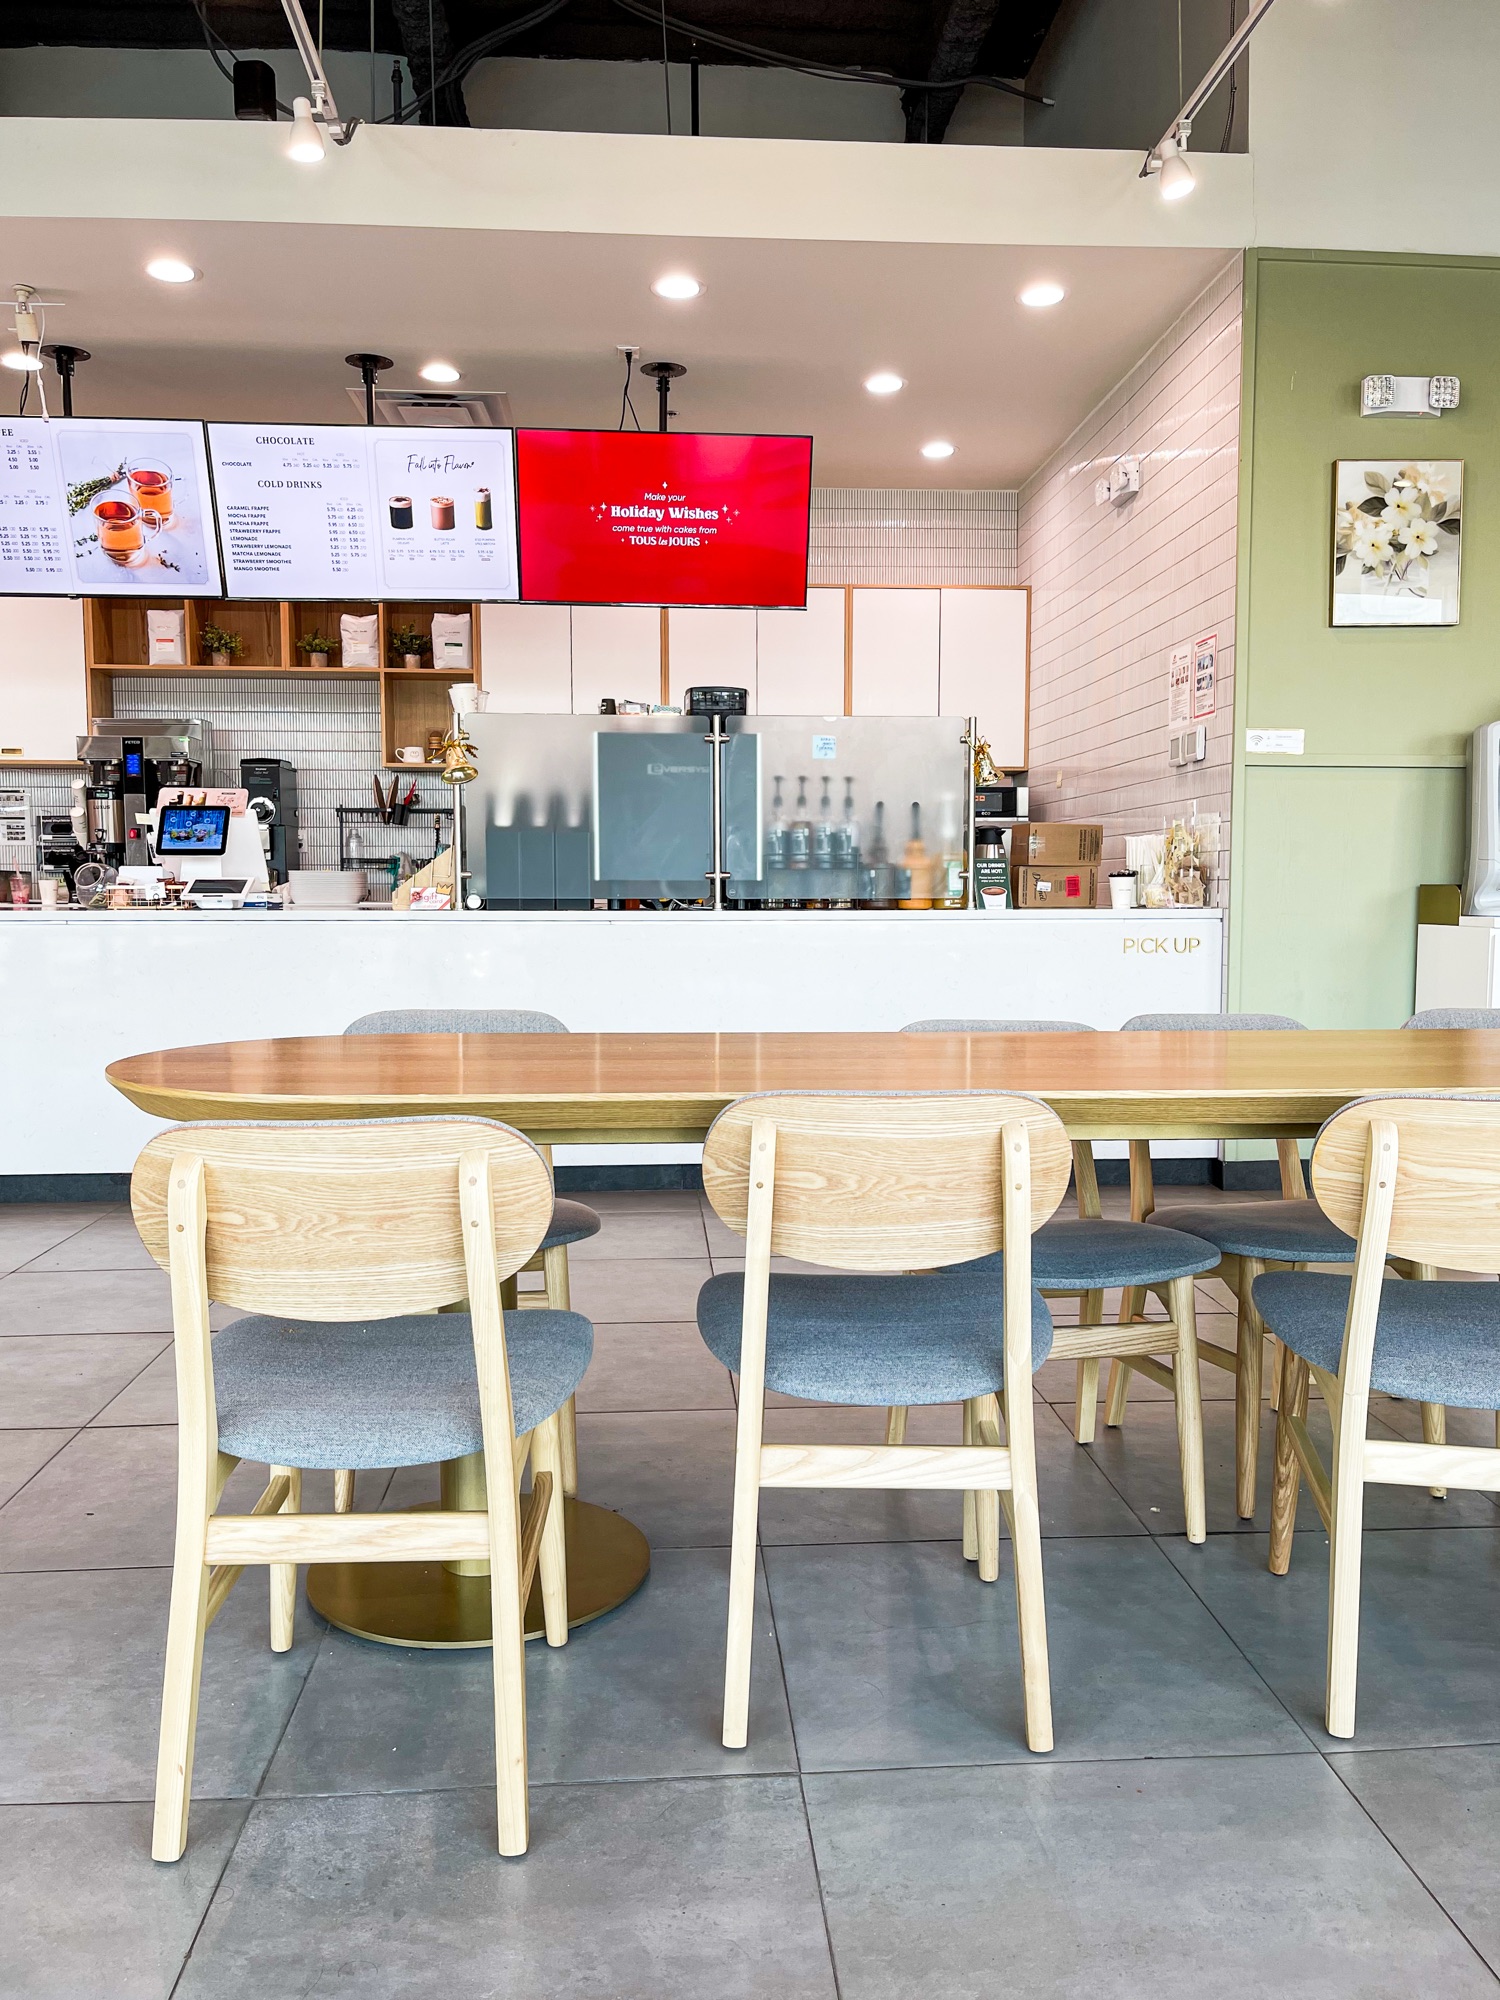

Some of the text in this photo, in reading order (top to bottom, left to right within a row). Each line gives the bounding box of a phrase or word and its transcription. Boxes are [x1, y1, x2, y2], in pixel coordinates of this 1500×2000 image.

[256, 436, 315, 445] CHOCOLATE
[407, 454, 426, 473] Fall
[428, 458, 441, 473] into
[258, 480, 322, 489] COLD DRINKS
[644, 492, 686, 502] Make your
[610, 505, 719, 522] Holiday Wishes
[655, 524, 672, 533] with
[673, 525, 697, 534] cakes
[698, 526, 717, 534] from
[629, 536, 700, 546] TOUS les JOURS
[424, 892, 437, 902] gift
[1123, 937, 1200, 954] PICK UP
